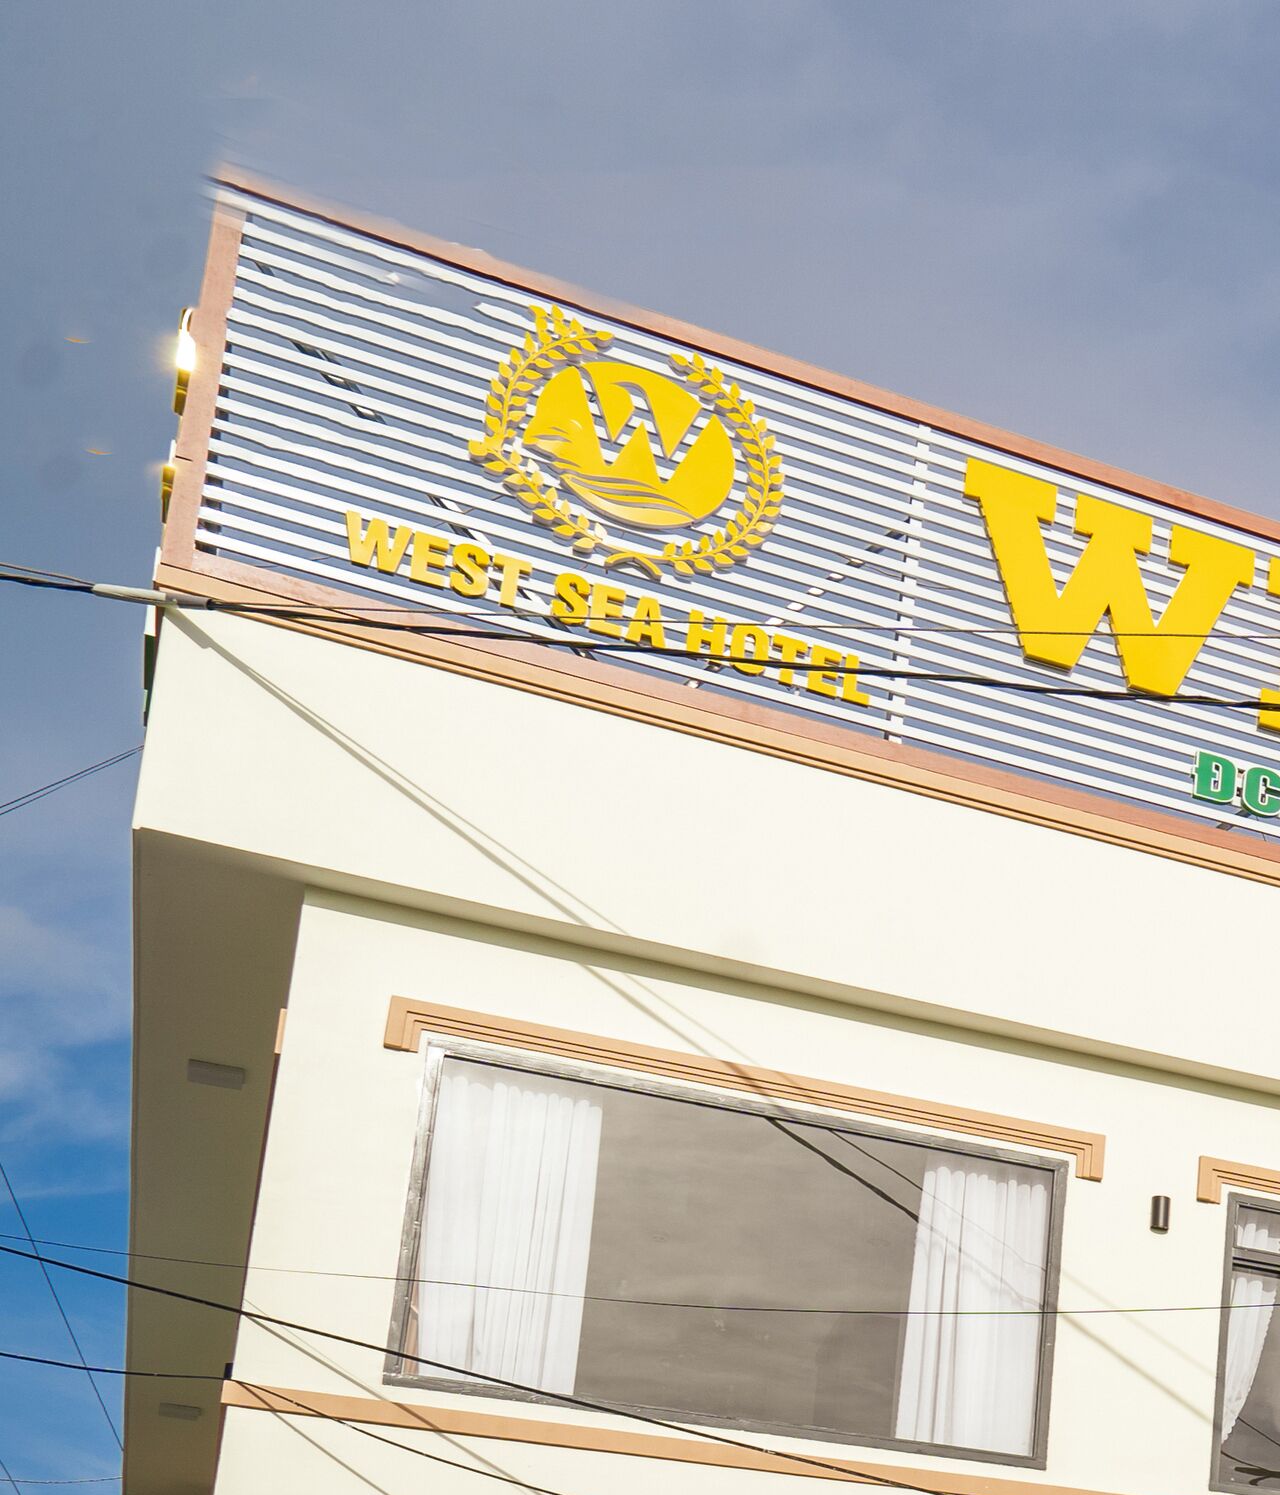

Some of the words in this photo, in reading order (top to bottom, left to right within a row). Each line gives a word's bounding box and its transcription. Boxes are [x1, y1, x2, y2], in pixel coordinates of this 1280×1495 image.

[345, 510, 532, 608] WEST
[551, 573, 665, 648] SEA
[686, 610, 870, 707] HOTEL
